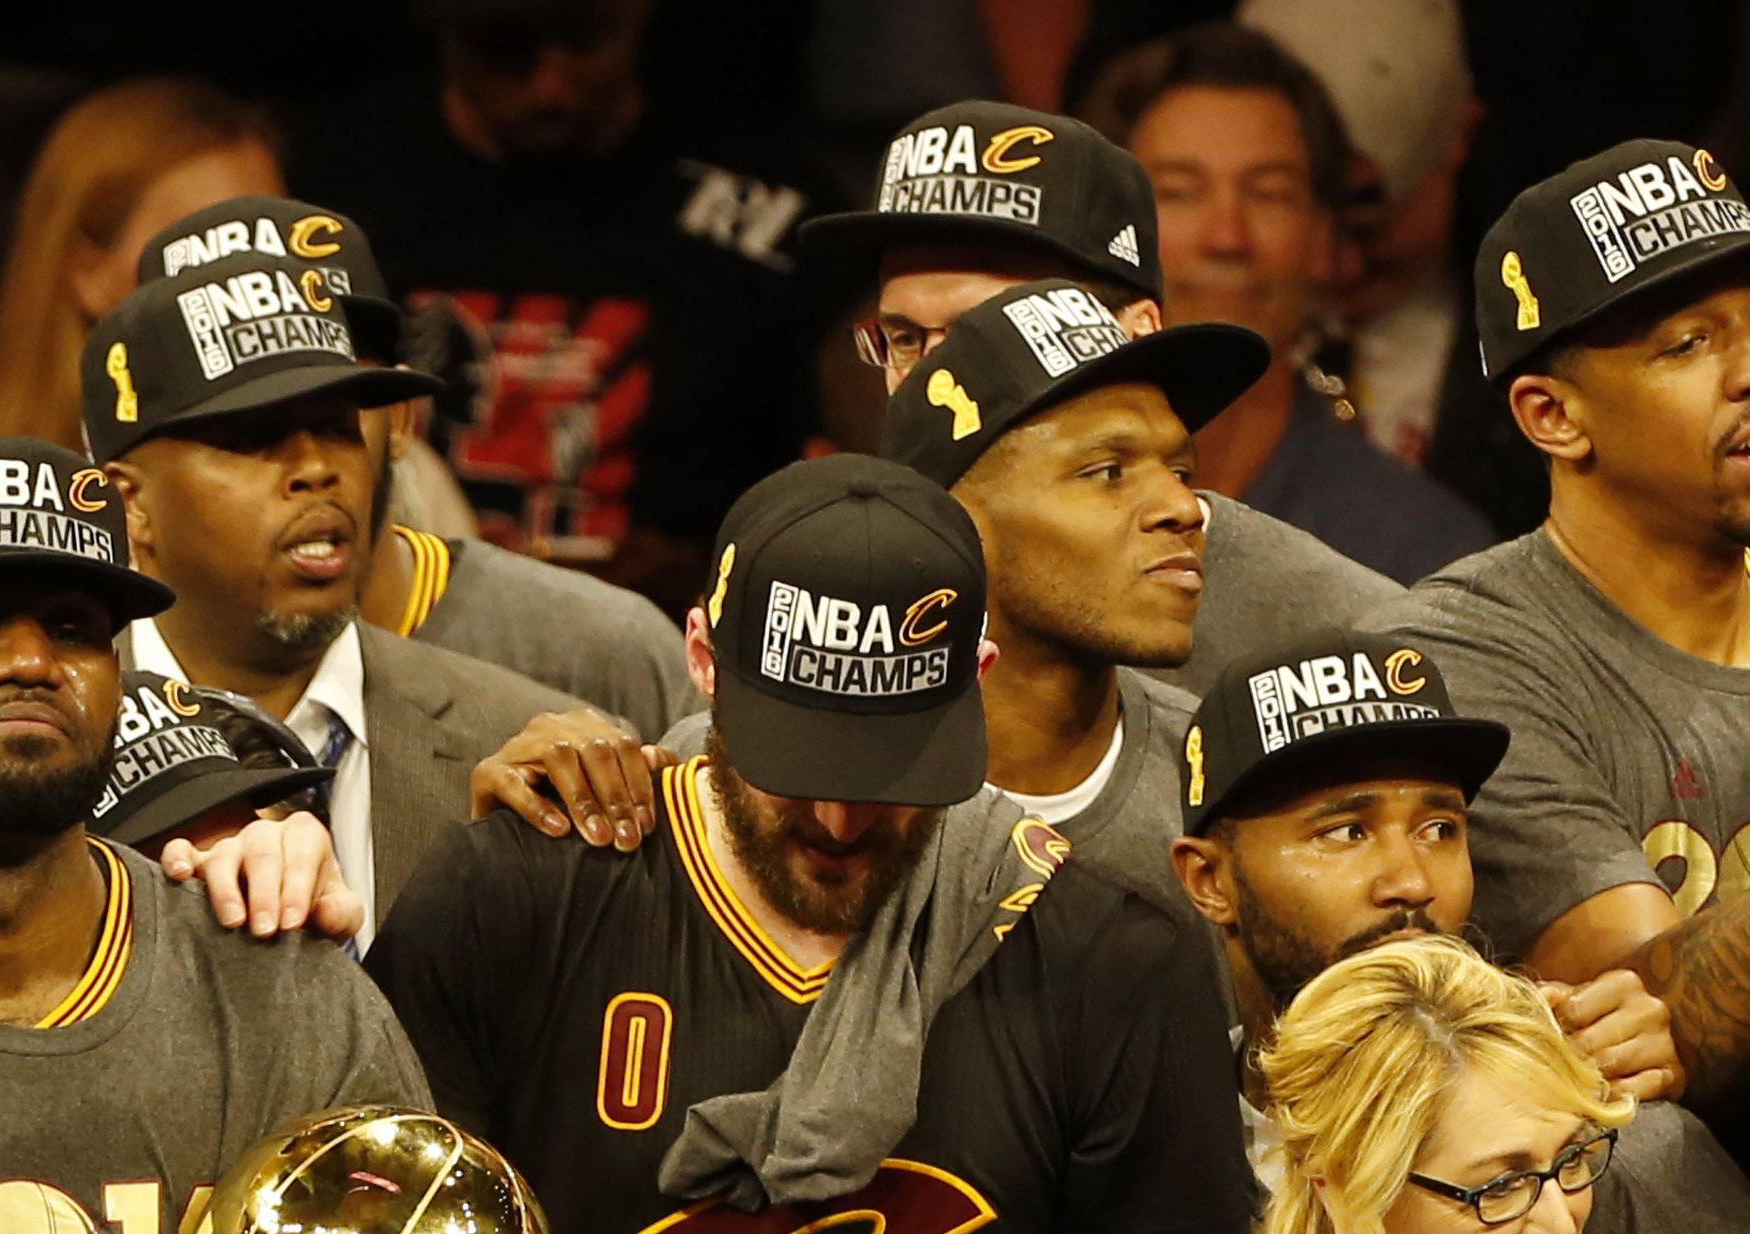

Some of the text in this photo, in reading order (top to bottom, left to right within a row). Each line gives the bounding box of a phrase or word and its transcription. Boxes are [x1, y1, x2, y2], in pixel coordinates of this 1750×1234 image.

[898, 125, 978, 178] NBA
[895, 178, 1037, 221] CHAMPS
[1597, 156, 1707, 227] NBA
[1572, 188, 1634, 281] 2016
[206, 270, 310, 327] NBA
[1005, 300, 1076, 376] 2016
[762, 583, 797, 678] 2016
[791, 588, 895, 654] NBA
[791, 650, 947, 694] CHAMPS
[1278, 652, 1388, 714] NBA
[114, 686, 180, 749] BA
[598, 992, 673, 1131] 0
